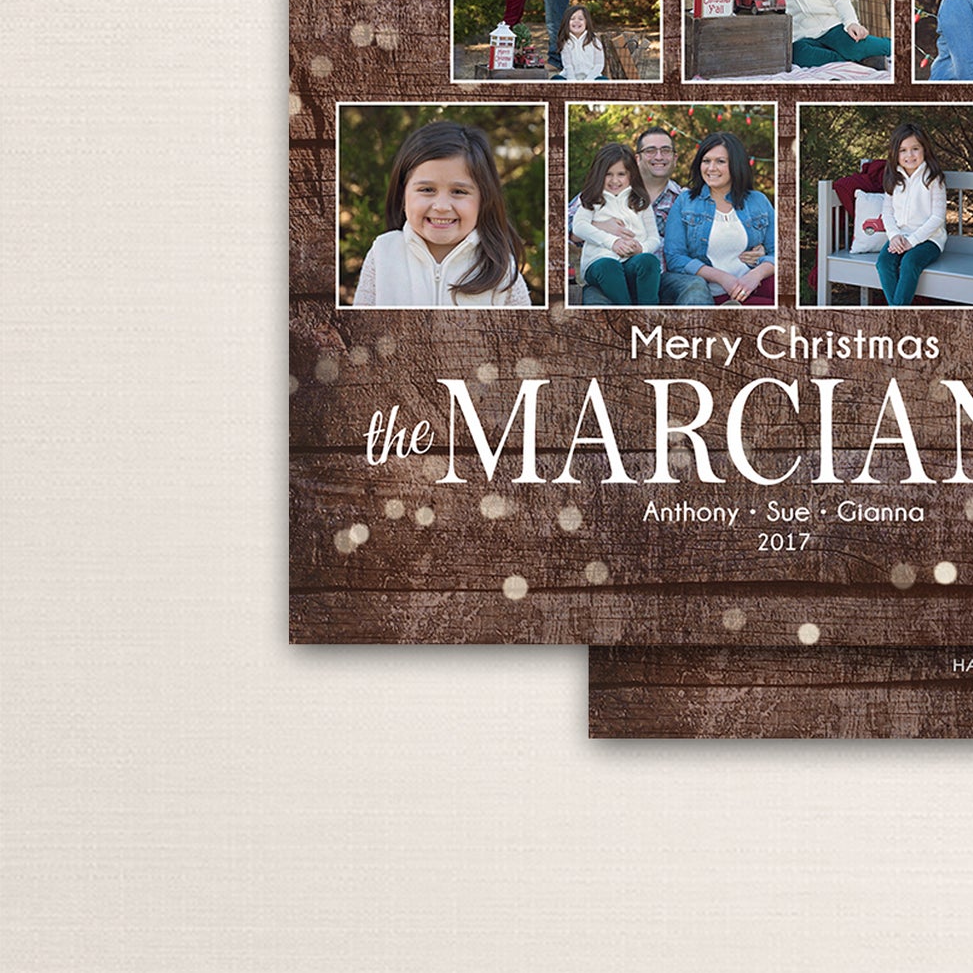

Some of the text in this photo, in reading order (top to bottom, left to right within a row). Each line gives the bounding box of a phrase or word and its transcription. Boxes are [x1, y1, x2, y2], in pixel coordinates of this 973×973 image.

[631, 324, 940, 367] Merry Christmas
[362, 404, 435, 466] the
[642, 500, 924, 527] Anthony Sue Gianna
[758, 532, 811, 551] 2017
